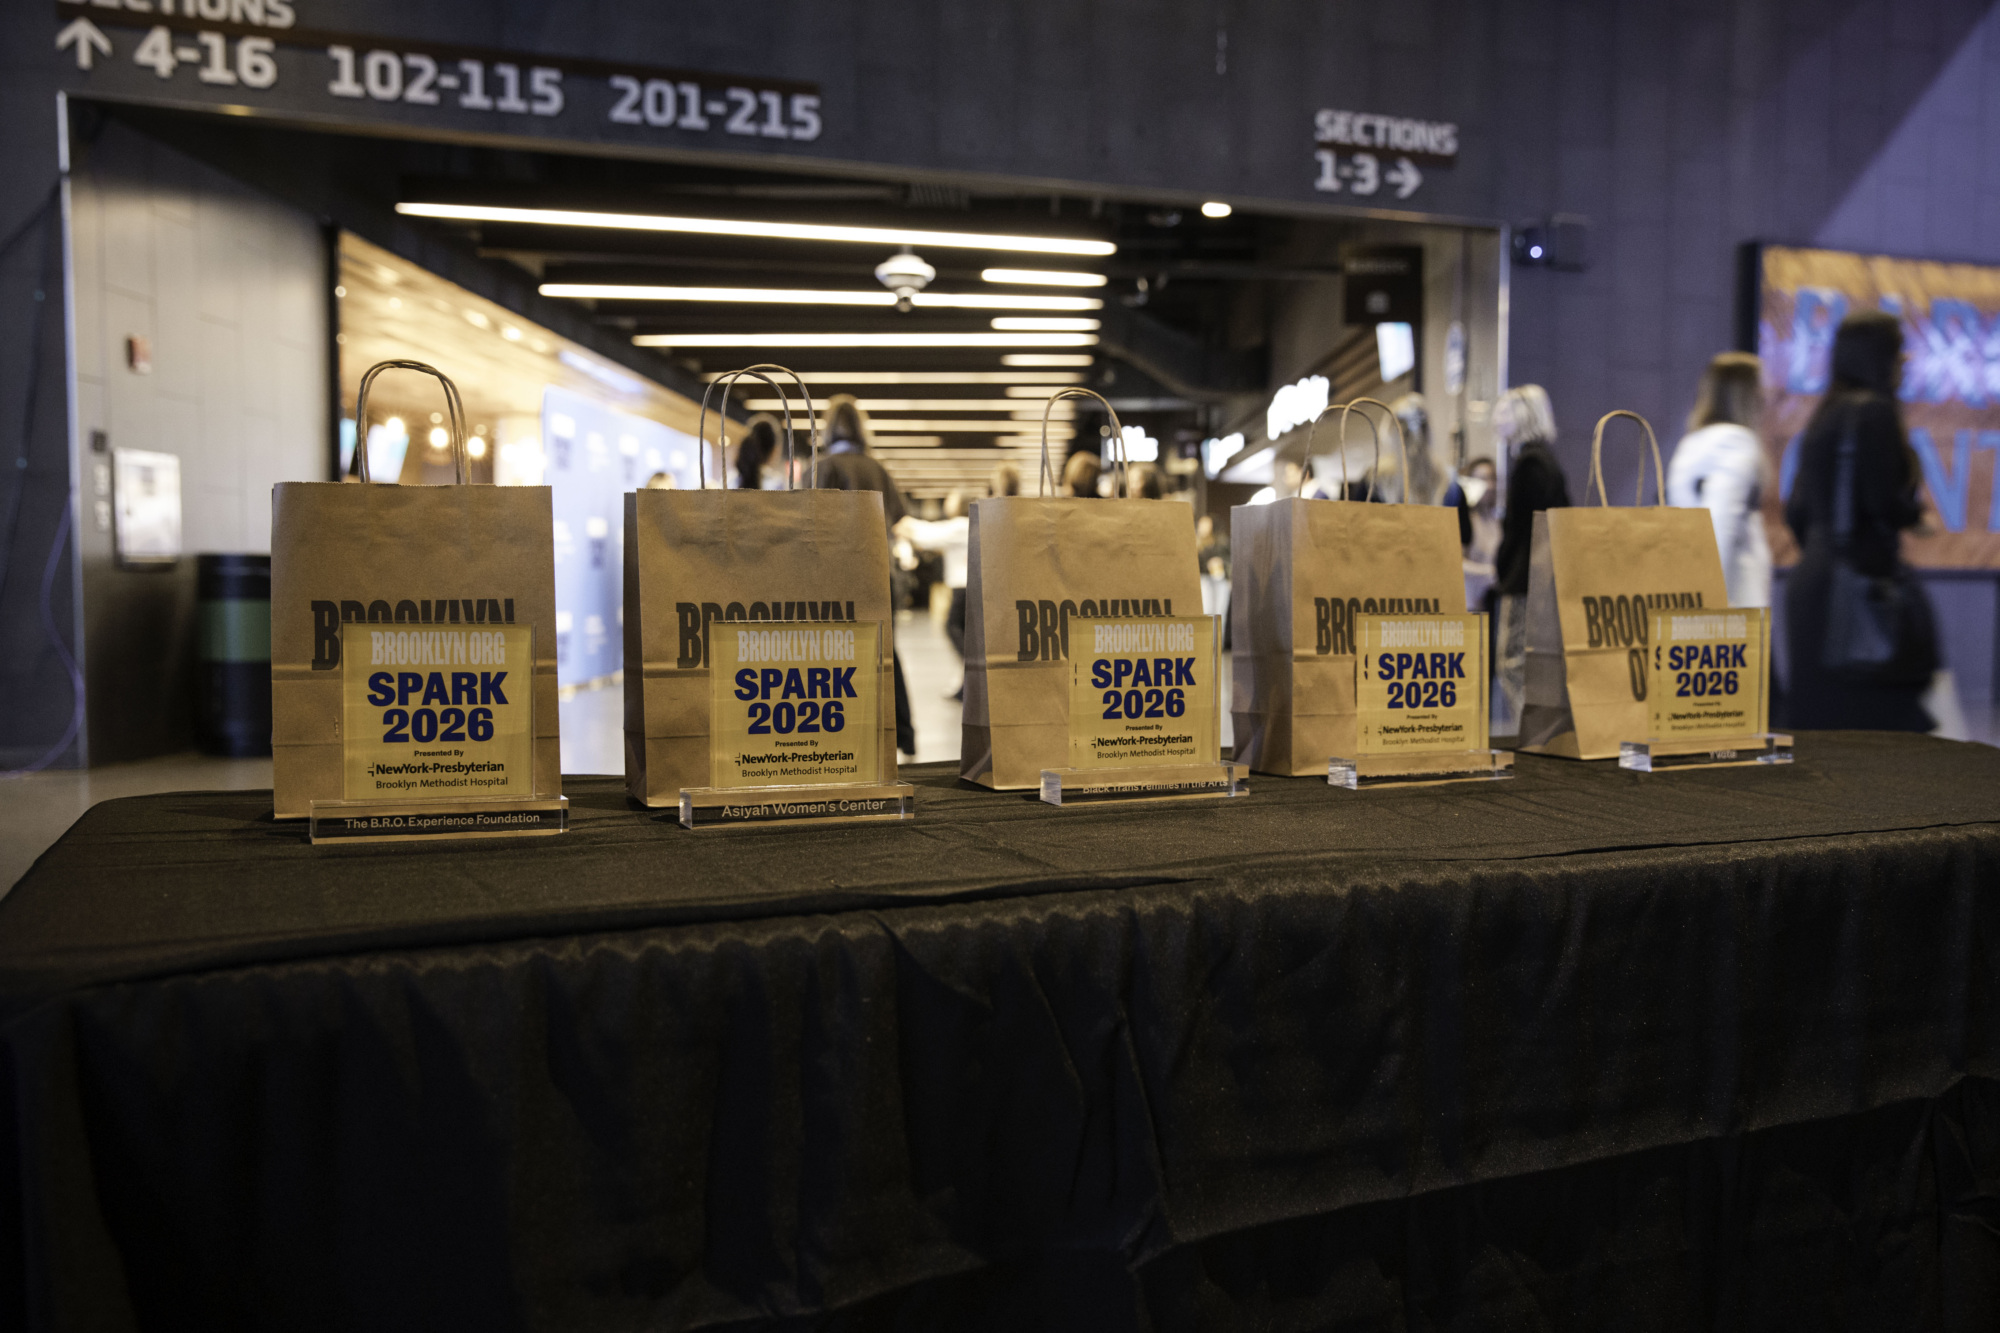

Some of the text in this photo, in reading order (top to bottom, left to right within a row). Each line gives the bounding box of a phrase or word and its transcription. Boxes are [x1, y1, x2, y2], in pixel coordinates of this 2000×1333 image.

[134, 24, 823, 141] 4-16 102-115 201-215
[1314, 108, 1459, 156] SECTIONS
[1314, 148, 1381, 196] 1-3
[371, 631, 466, 665] BROOKLYN
[469, 631, 505, 664] ORG
[737, 630, 820, 662] BROOKLYN
[823, 629, 855, 661] ORG
[1094, 624, 1165, 653] BROOKLYN
[1167, 623, 1194, 652] ORG
[1378, 652, 1466, 680] SPARK
[1668, 643, 1747, 671] SPARK
[734, 667, 857, 701] SPARK
[1091, 657, 1196, 689] SPARK
[1676, 670, 1738, 697] 2026
[367, 671, 509, 706] SPARK
[1387, 681, 1456, 709] 2026
[748, 701, 845, 735] 2026
[1102, 688, 1186, 720] 2026
[382, 707, 494, 743] 2026
[1155, 724, 1163, 732] By
[1382, 724, 1463, 734] NewYork-Presbyterian
[454, 749, 464, 758] By
[775, 739, 819, 748] Presented By
[1097, 734, 1193, 748] NewYork-Presbyterian
[1097, 747, 1196, 760] Brooklyn Methodist Hospital
[376, 762, 504, 776] NewYork-Presbyterian
[741, 765, 857, 779] Brooklyn Methodist Hospital
[742, 751, 854, 765] NewYork-Presbyterian
[376, 776, 508, 790] Brooklyn Methodist Hospital
[345, 813, 540, 829] The B.R.O. Experience Foundation
[722, 799, 886, 819] Asiyah Women's Center
